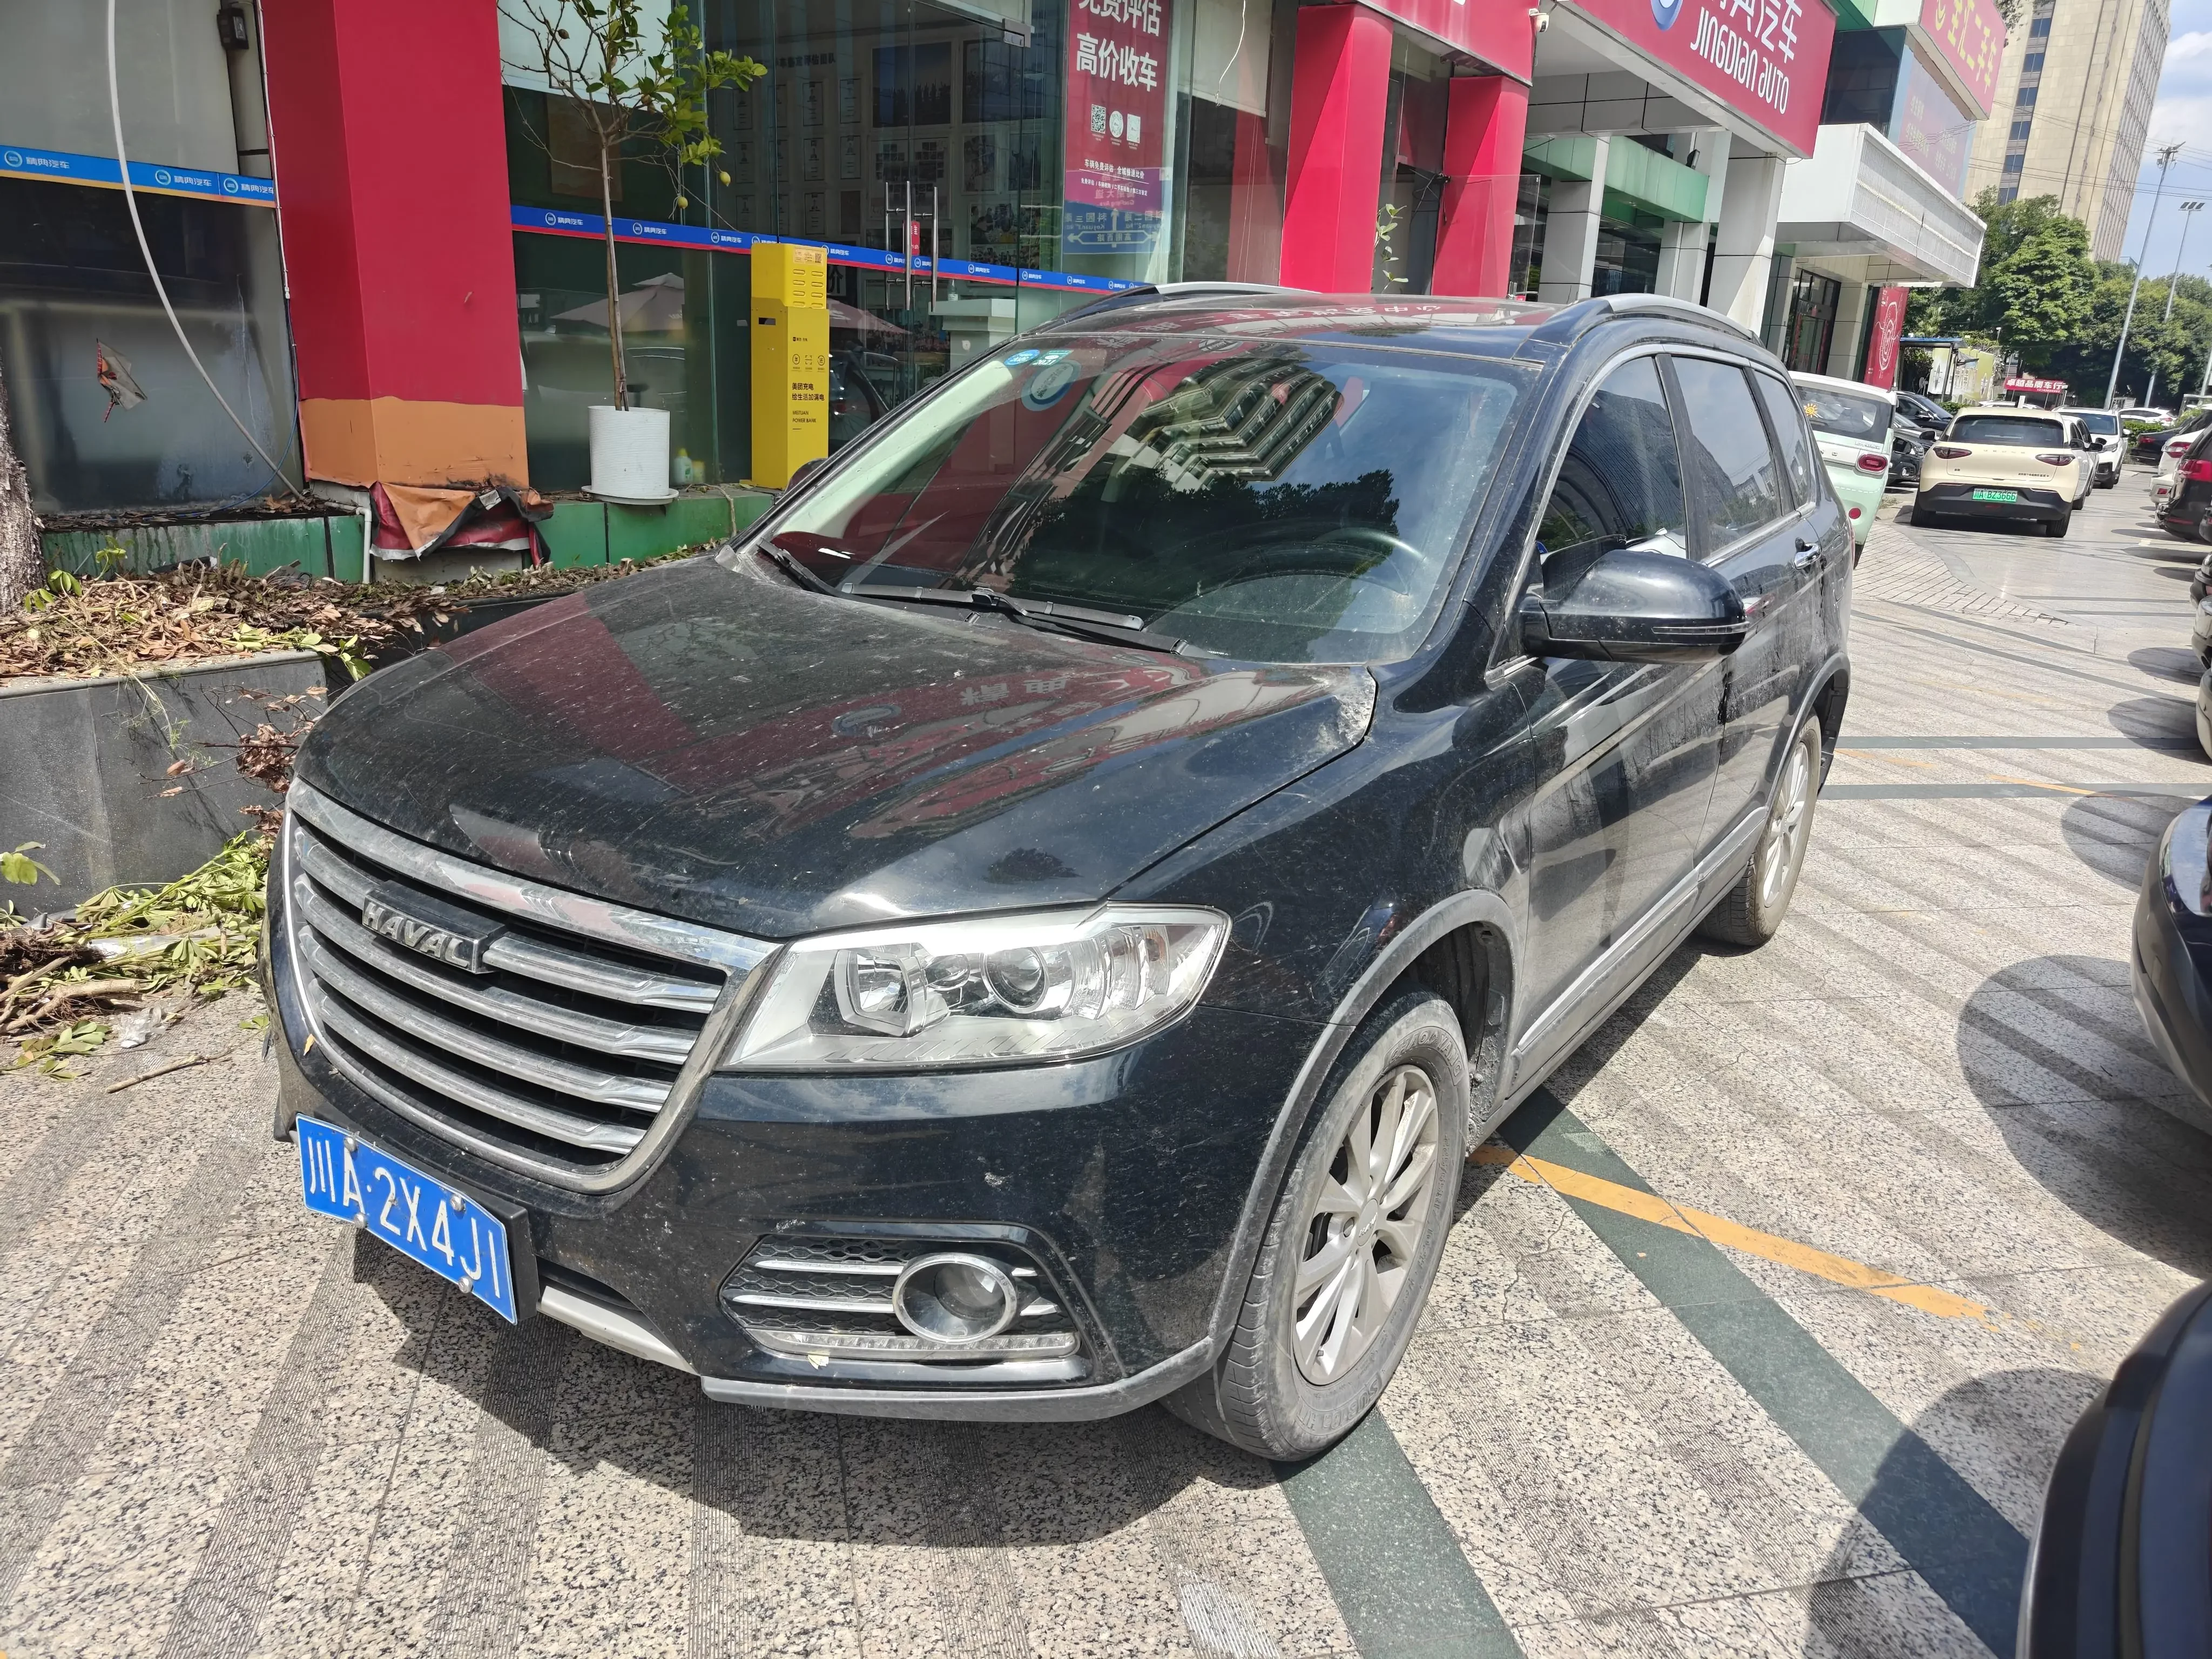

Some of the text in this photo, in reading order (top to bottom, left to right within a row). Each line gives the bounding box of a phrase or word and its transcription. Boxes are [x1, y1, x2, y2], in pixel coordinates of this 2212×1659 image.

[1076, 32, 1158, 92] 高价收车
[25, 156, 70, 169] 精典汽车
[173, 175, 212, 187] 精典汽车
[362, 901, 469, 968] HAVAL
